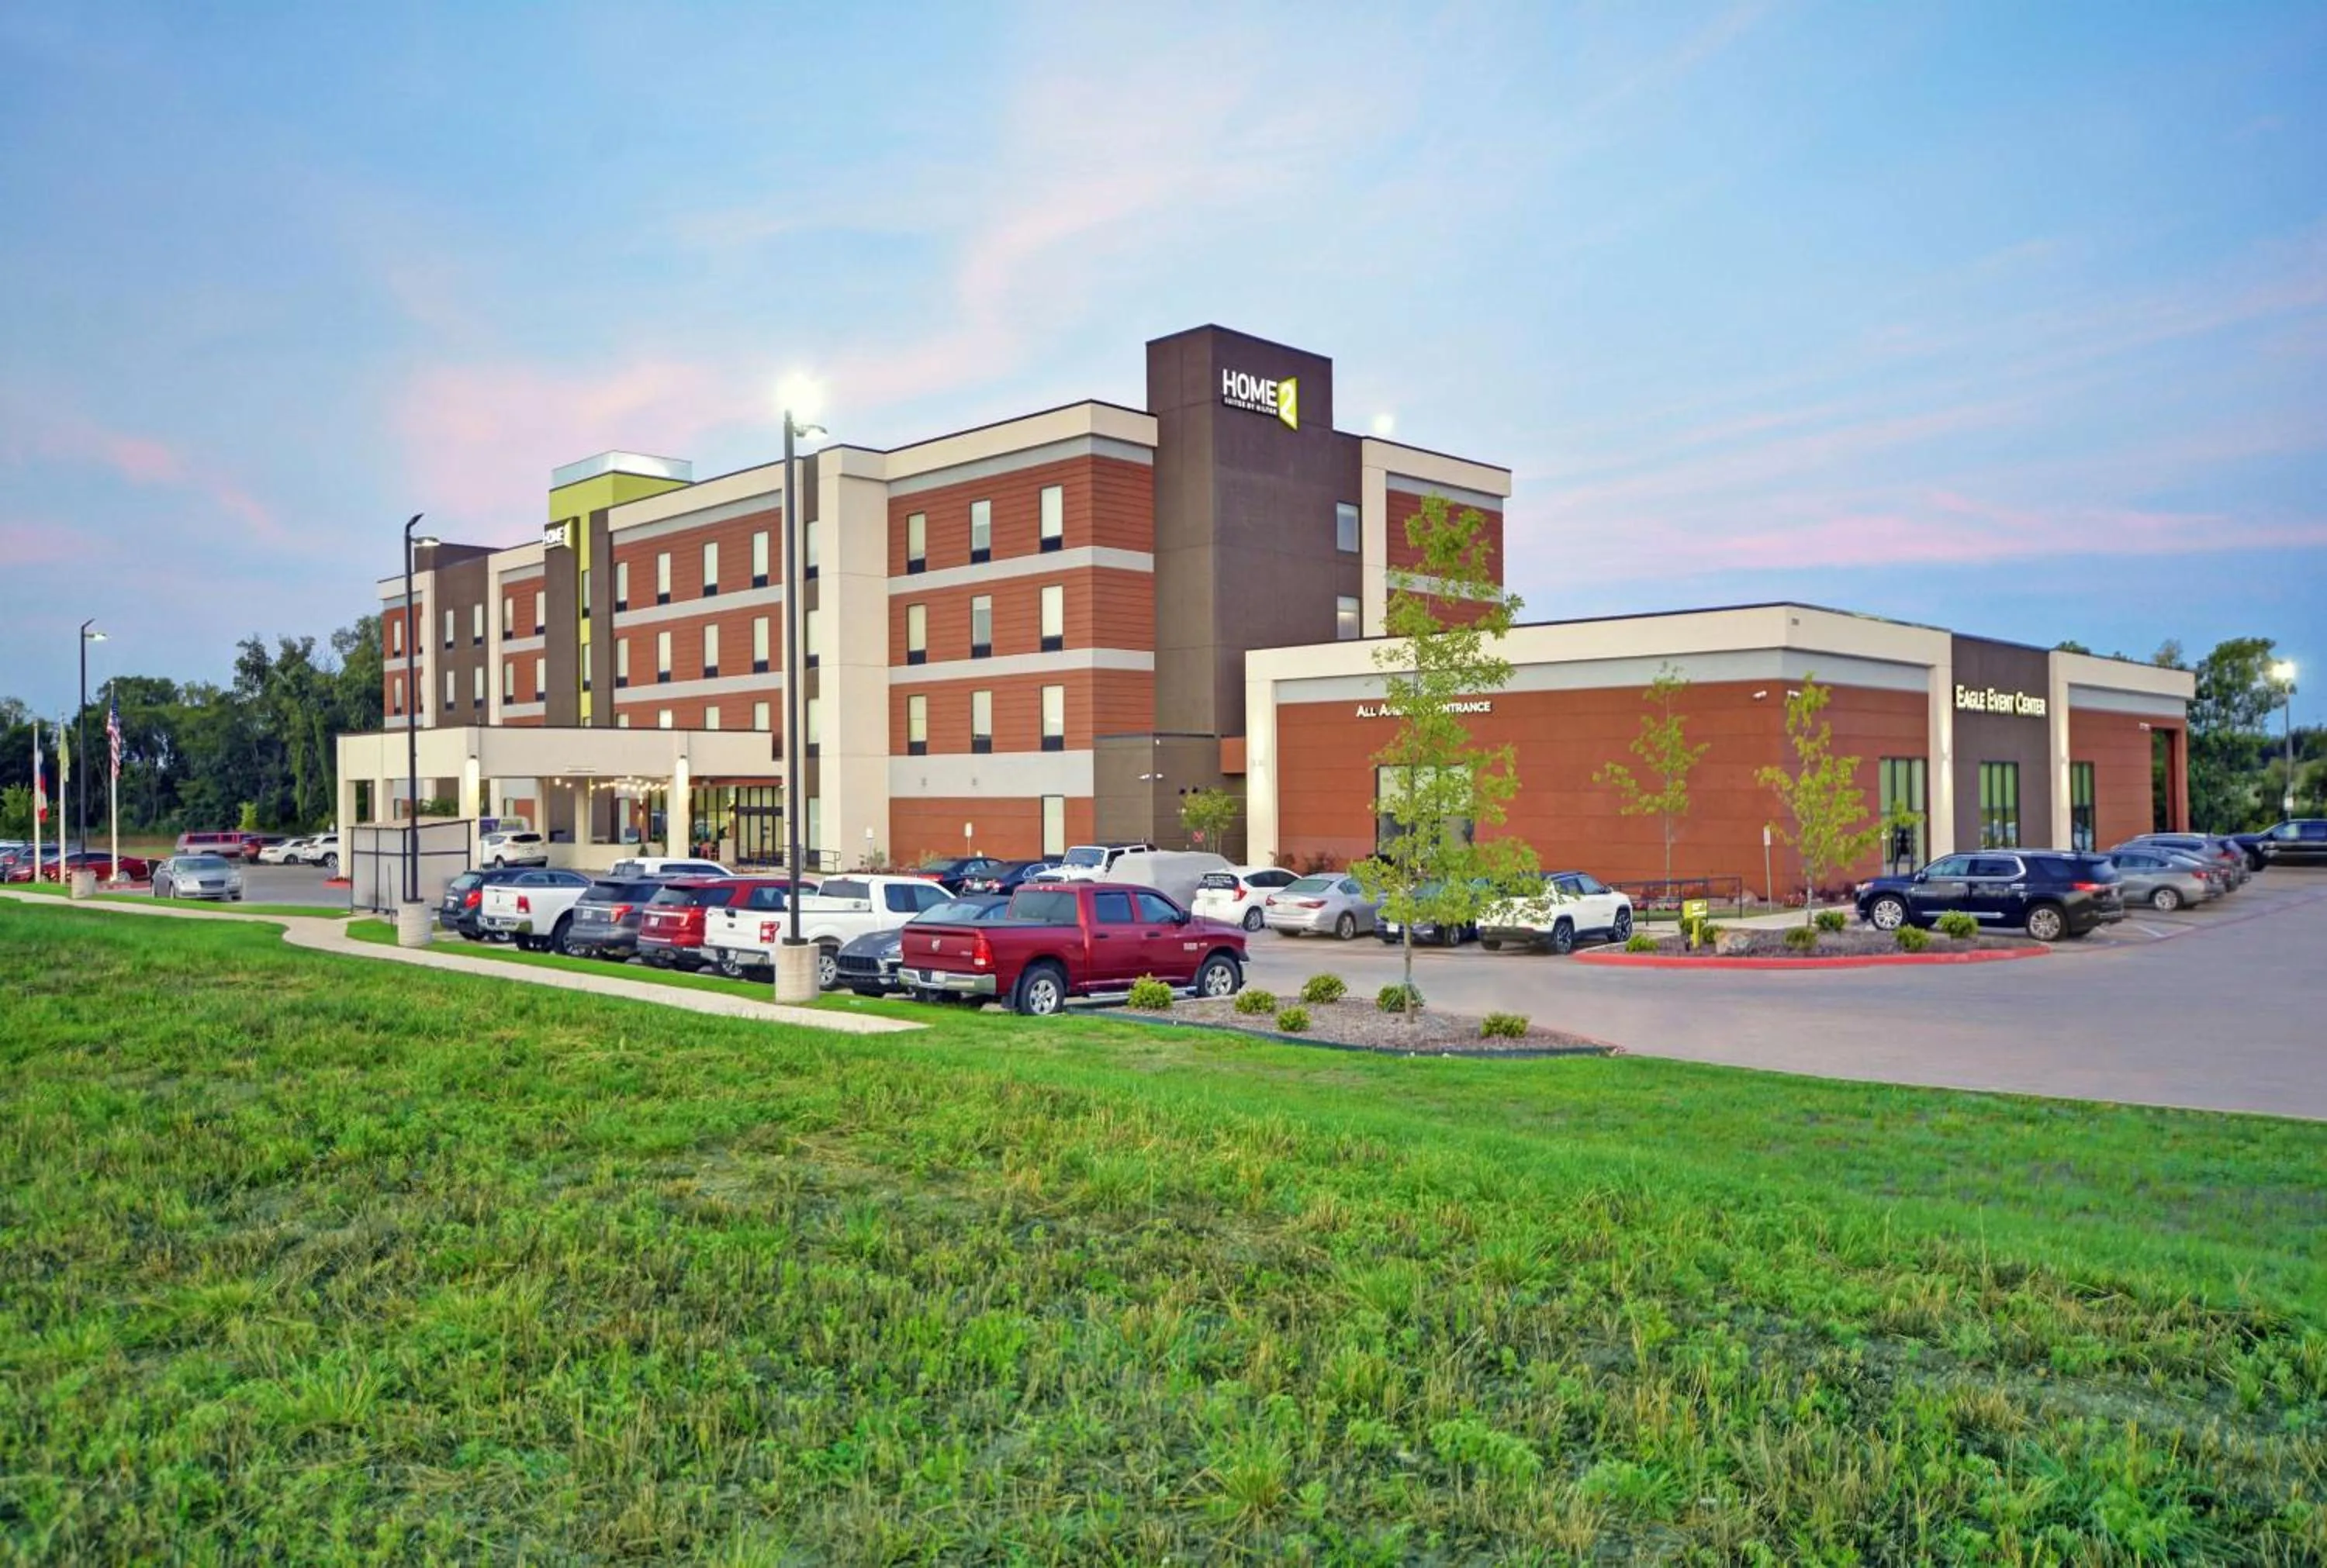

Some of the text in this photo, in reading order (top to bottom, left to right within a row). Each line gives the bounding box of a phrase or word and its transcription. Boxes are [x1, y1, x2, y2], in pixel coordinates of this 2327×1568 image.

[1222, 368, 1298, 430] HOME 2
[1355, 705, 1377, 717] ALL
[1955, 685, 2045, 717] EAGLE EVENT CENTER
